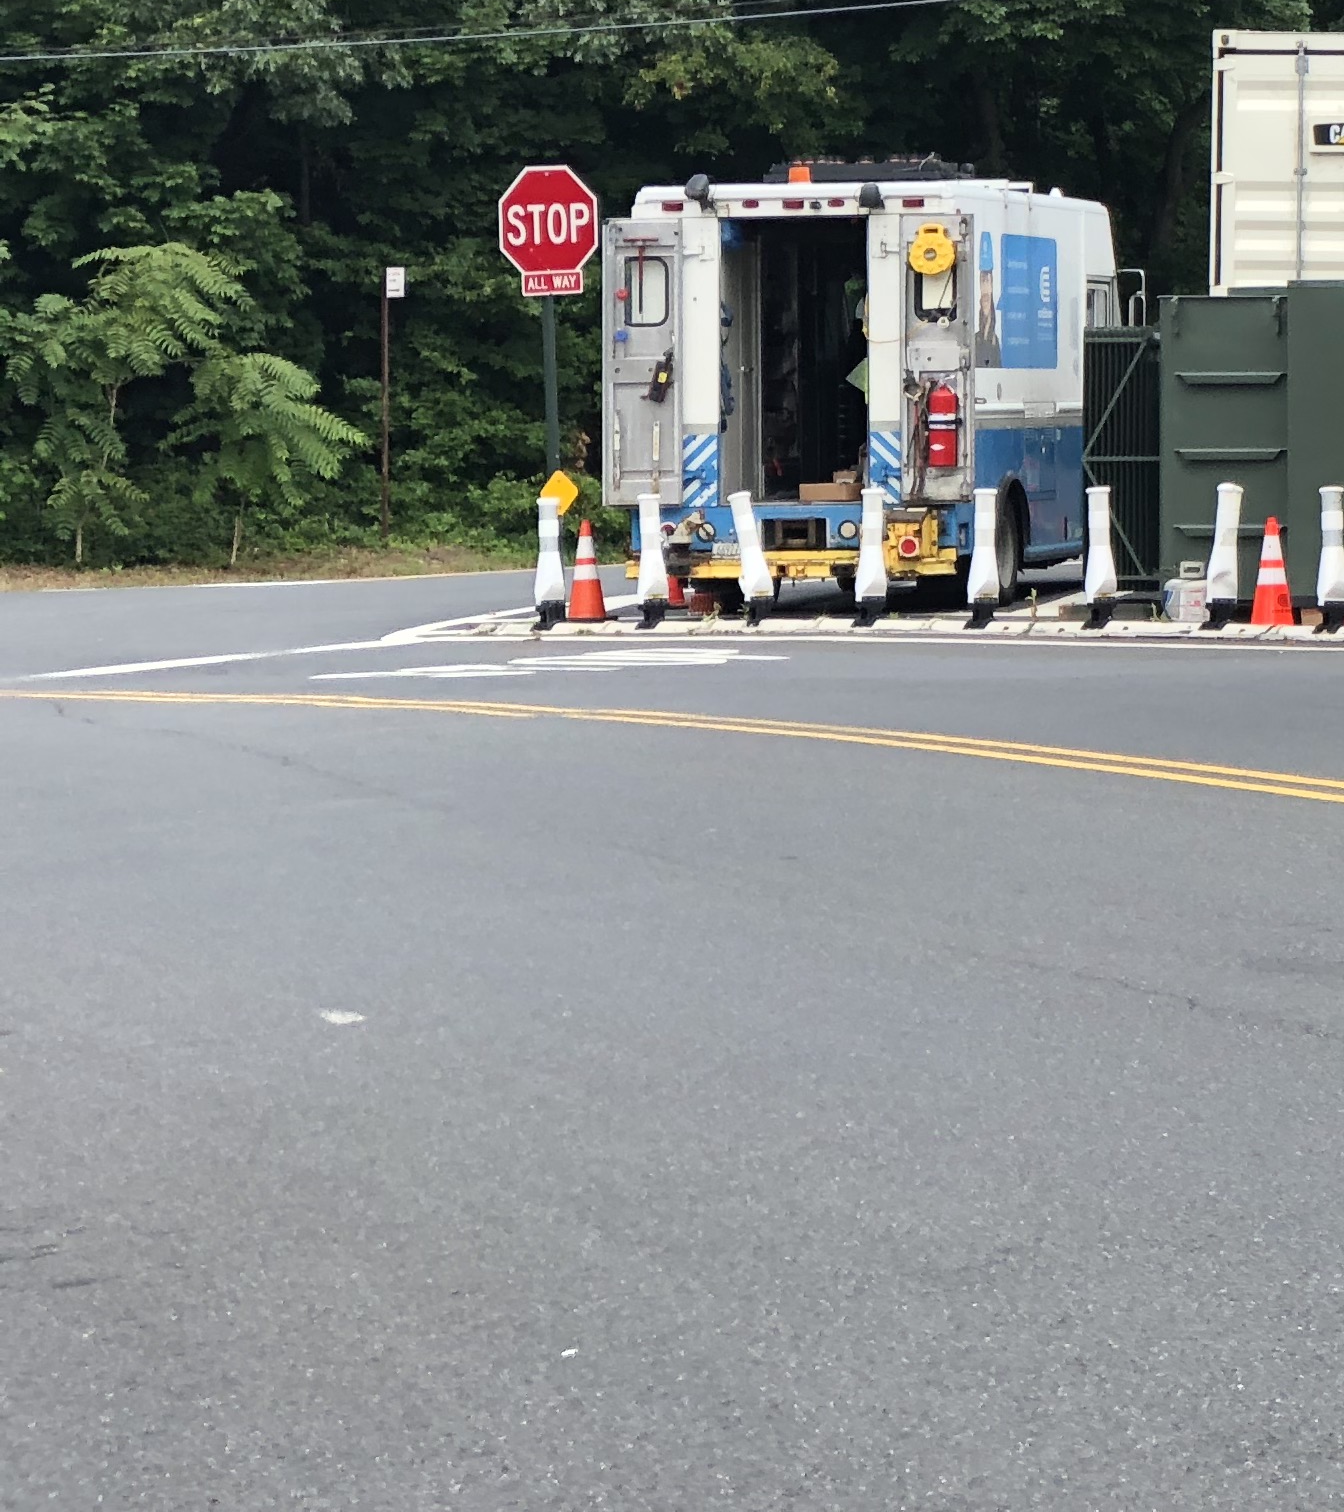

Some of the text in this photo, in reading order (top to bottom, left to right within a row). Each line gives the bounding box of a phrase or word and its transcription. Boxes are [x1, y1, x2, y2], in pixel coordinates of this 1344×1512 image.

[507, 202, 590, 246] STOP
[527, 275, 577, 290] ALL WAY
